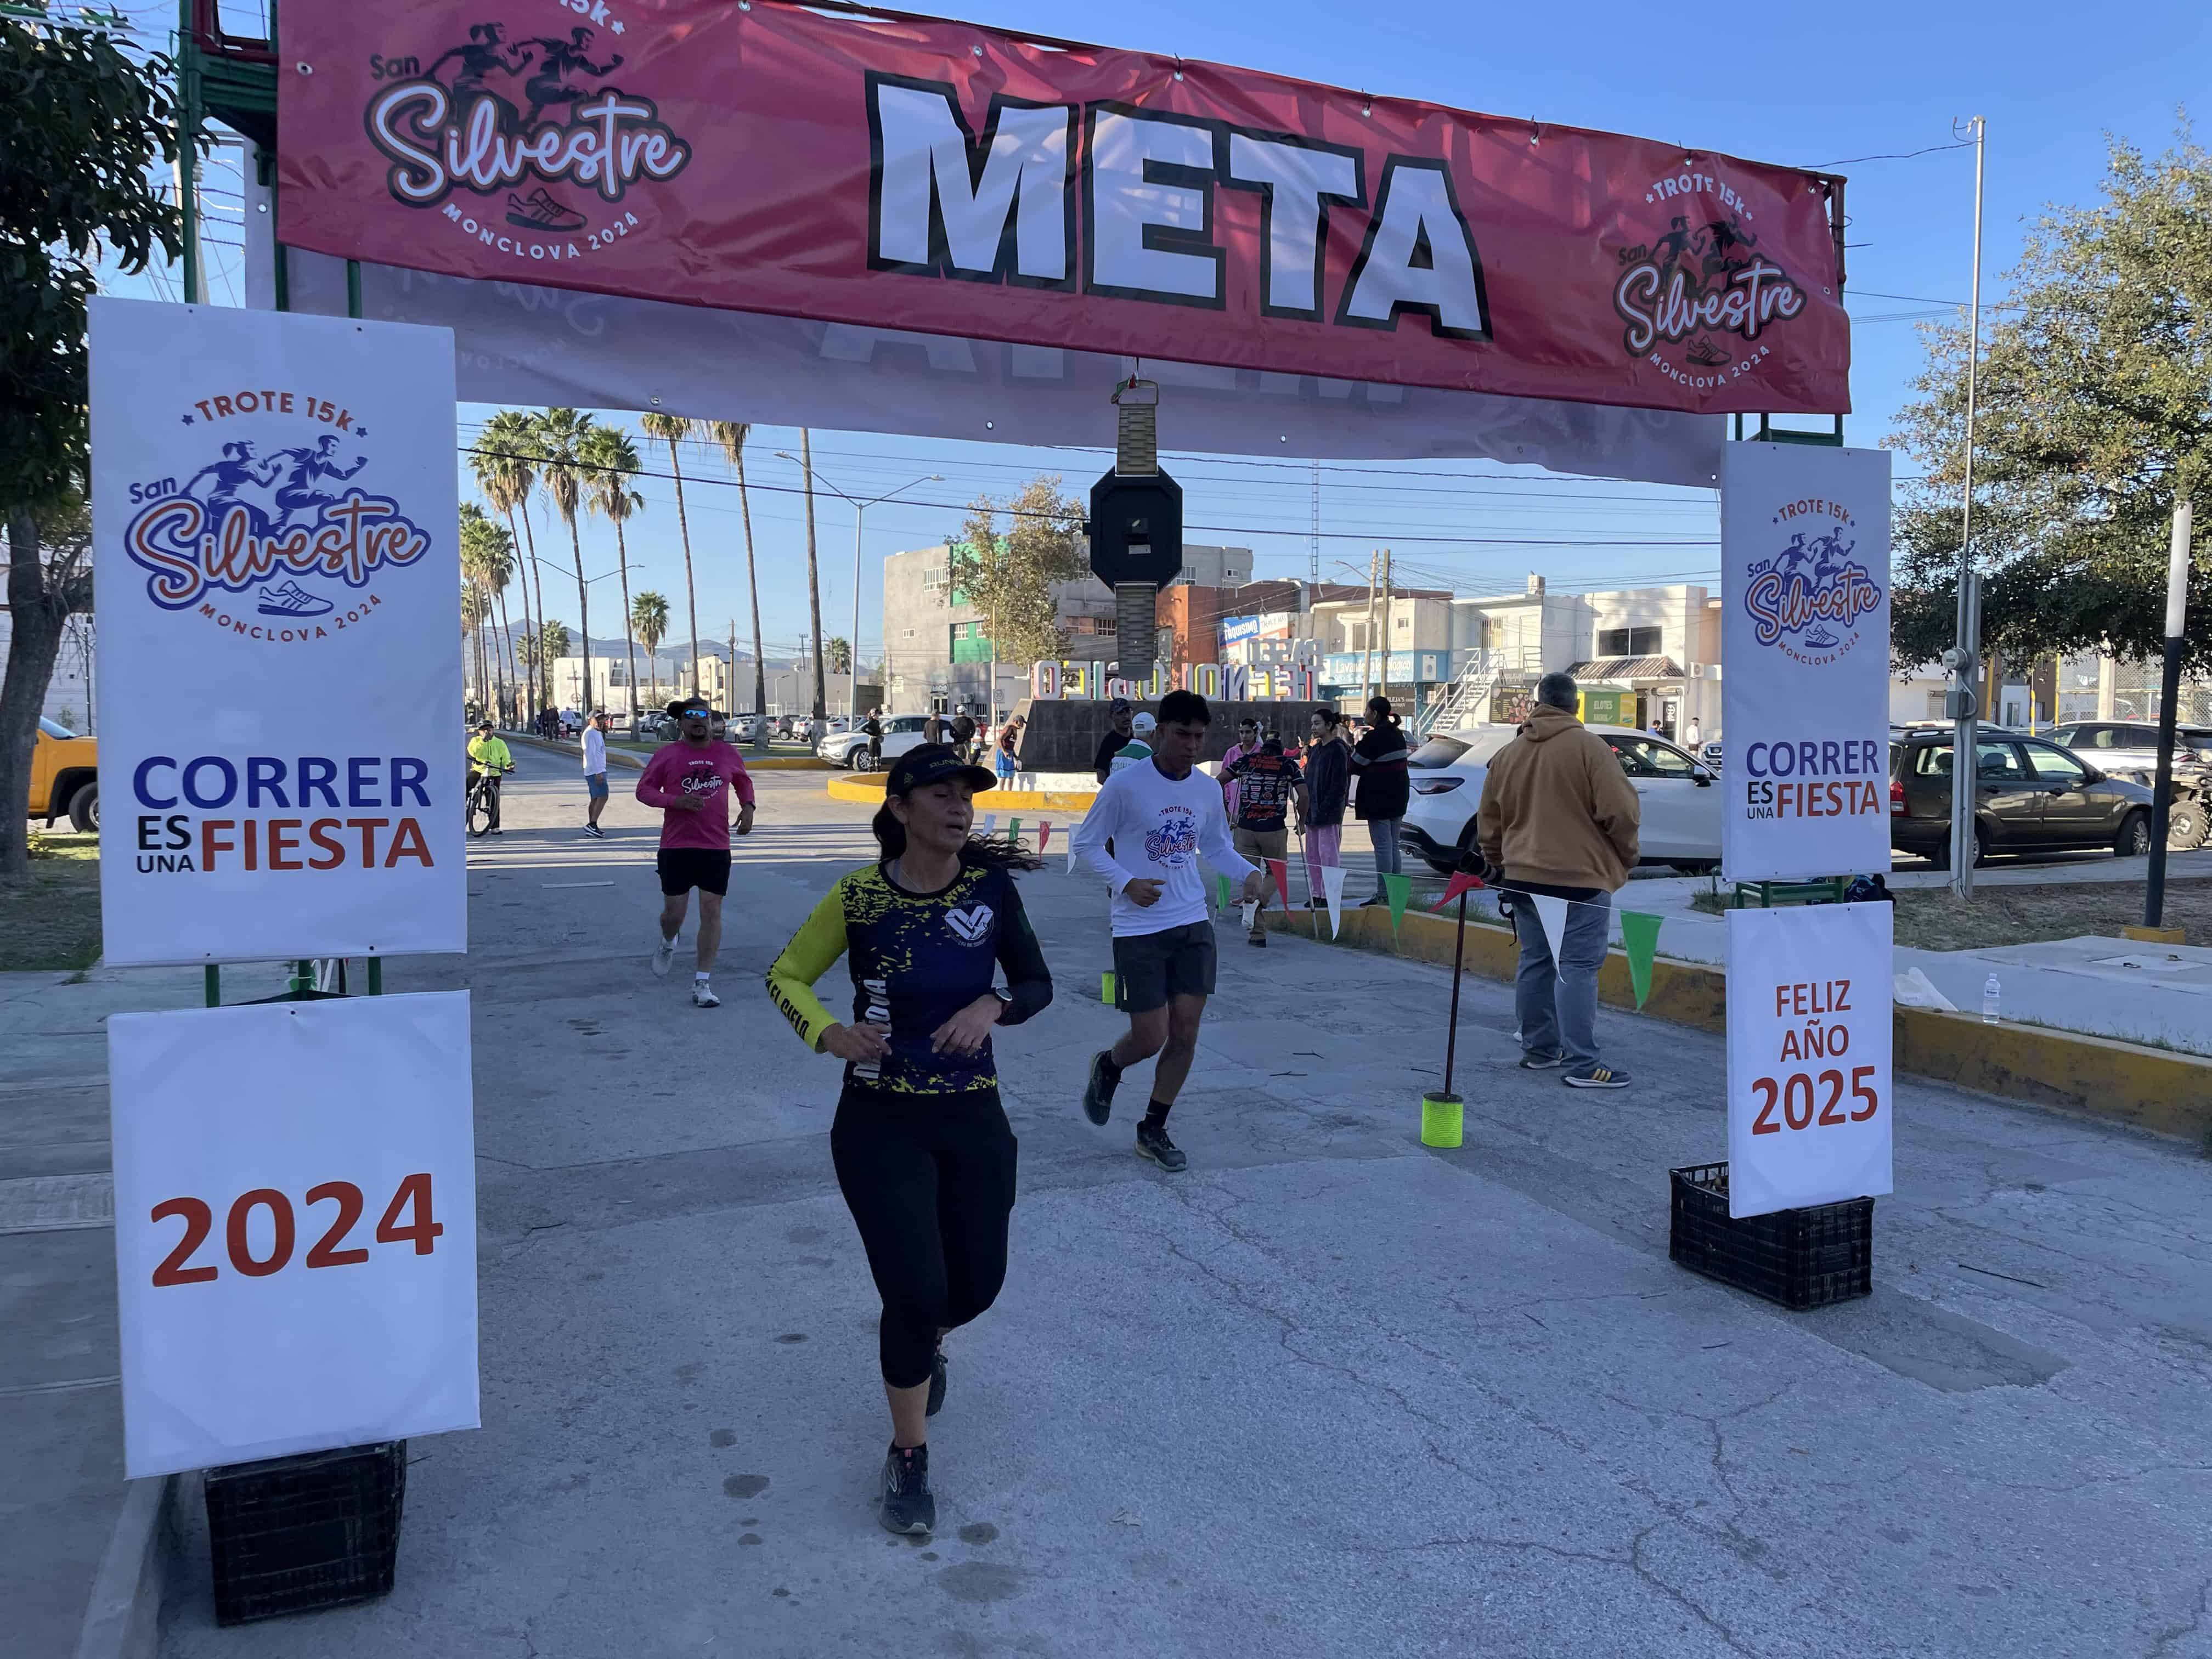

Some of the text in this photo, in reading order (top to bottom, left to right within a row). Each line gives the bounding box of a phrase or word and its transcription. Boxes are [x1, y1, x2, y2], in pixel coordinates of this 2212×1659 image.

[369, 54, 420, 80] San
[373, 82, 686, 200] Silvestre
[865, 69, 1493, 341] META
[1652, 173, 1714, 201] TROTE
[442, 202, 639, 260] MONCLOVA 2024
[1618, 244, 1646, 267] San
[1618, 260, 1804, 350] Silvestre
[1650, 345, 1770, 388] MONCLOVA 2024
[194, 391, 295, 422] TROTE
[129, 476, 177, 505] San
[1778, 499, 1824, 522] TROTE
[132, 494, 427, 603] Silvestre
[1747, 558, 1771, 578] San
[198, 593, 382, 642] MONCLOVA 2024
[1748, 566, 1881, 641] Silvestre
[1778, 631, 1860, 665] MONCLOVA 2024
[1746, 740, 1880, 777] CORRER
[132, 755, 432, 810] CORRER
[1747, 781, 1774, 805] ES
[1776, 781, 1880, 819] FIESTA
[1160, 806, 1181, 816] TROTE
[1747, 806, 1774, 820] UNA
[137, 814, 192, 851] ES
[201, 817, 435, 872] FIESTA
[136, 854, 196, 874] UNA
[1775, 979, 1852, 1017] FELIZ
[1780, 1018, 1849, 1063] AÑO
[1752, 1065, 1878, 1136] 2025
[150, 1172, 444, 1288] 2024
